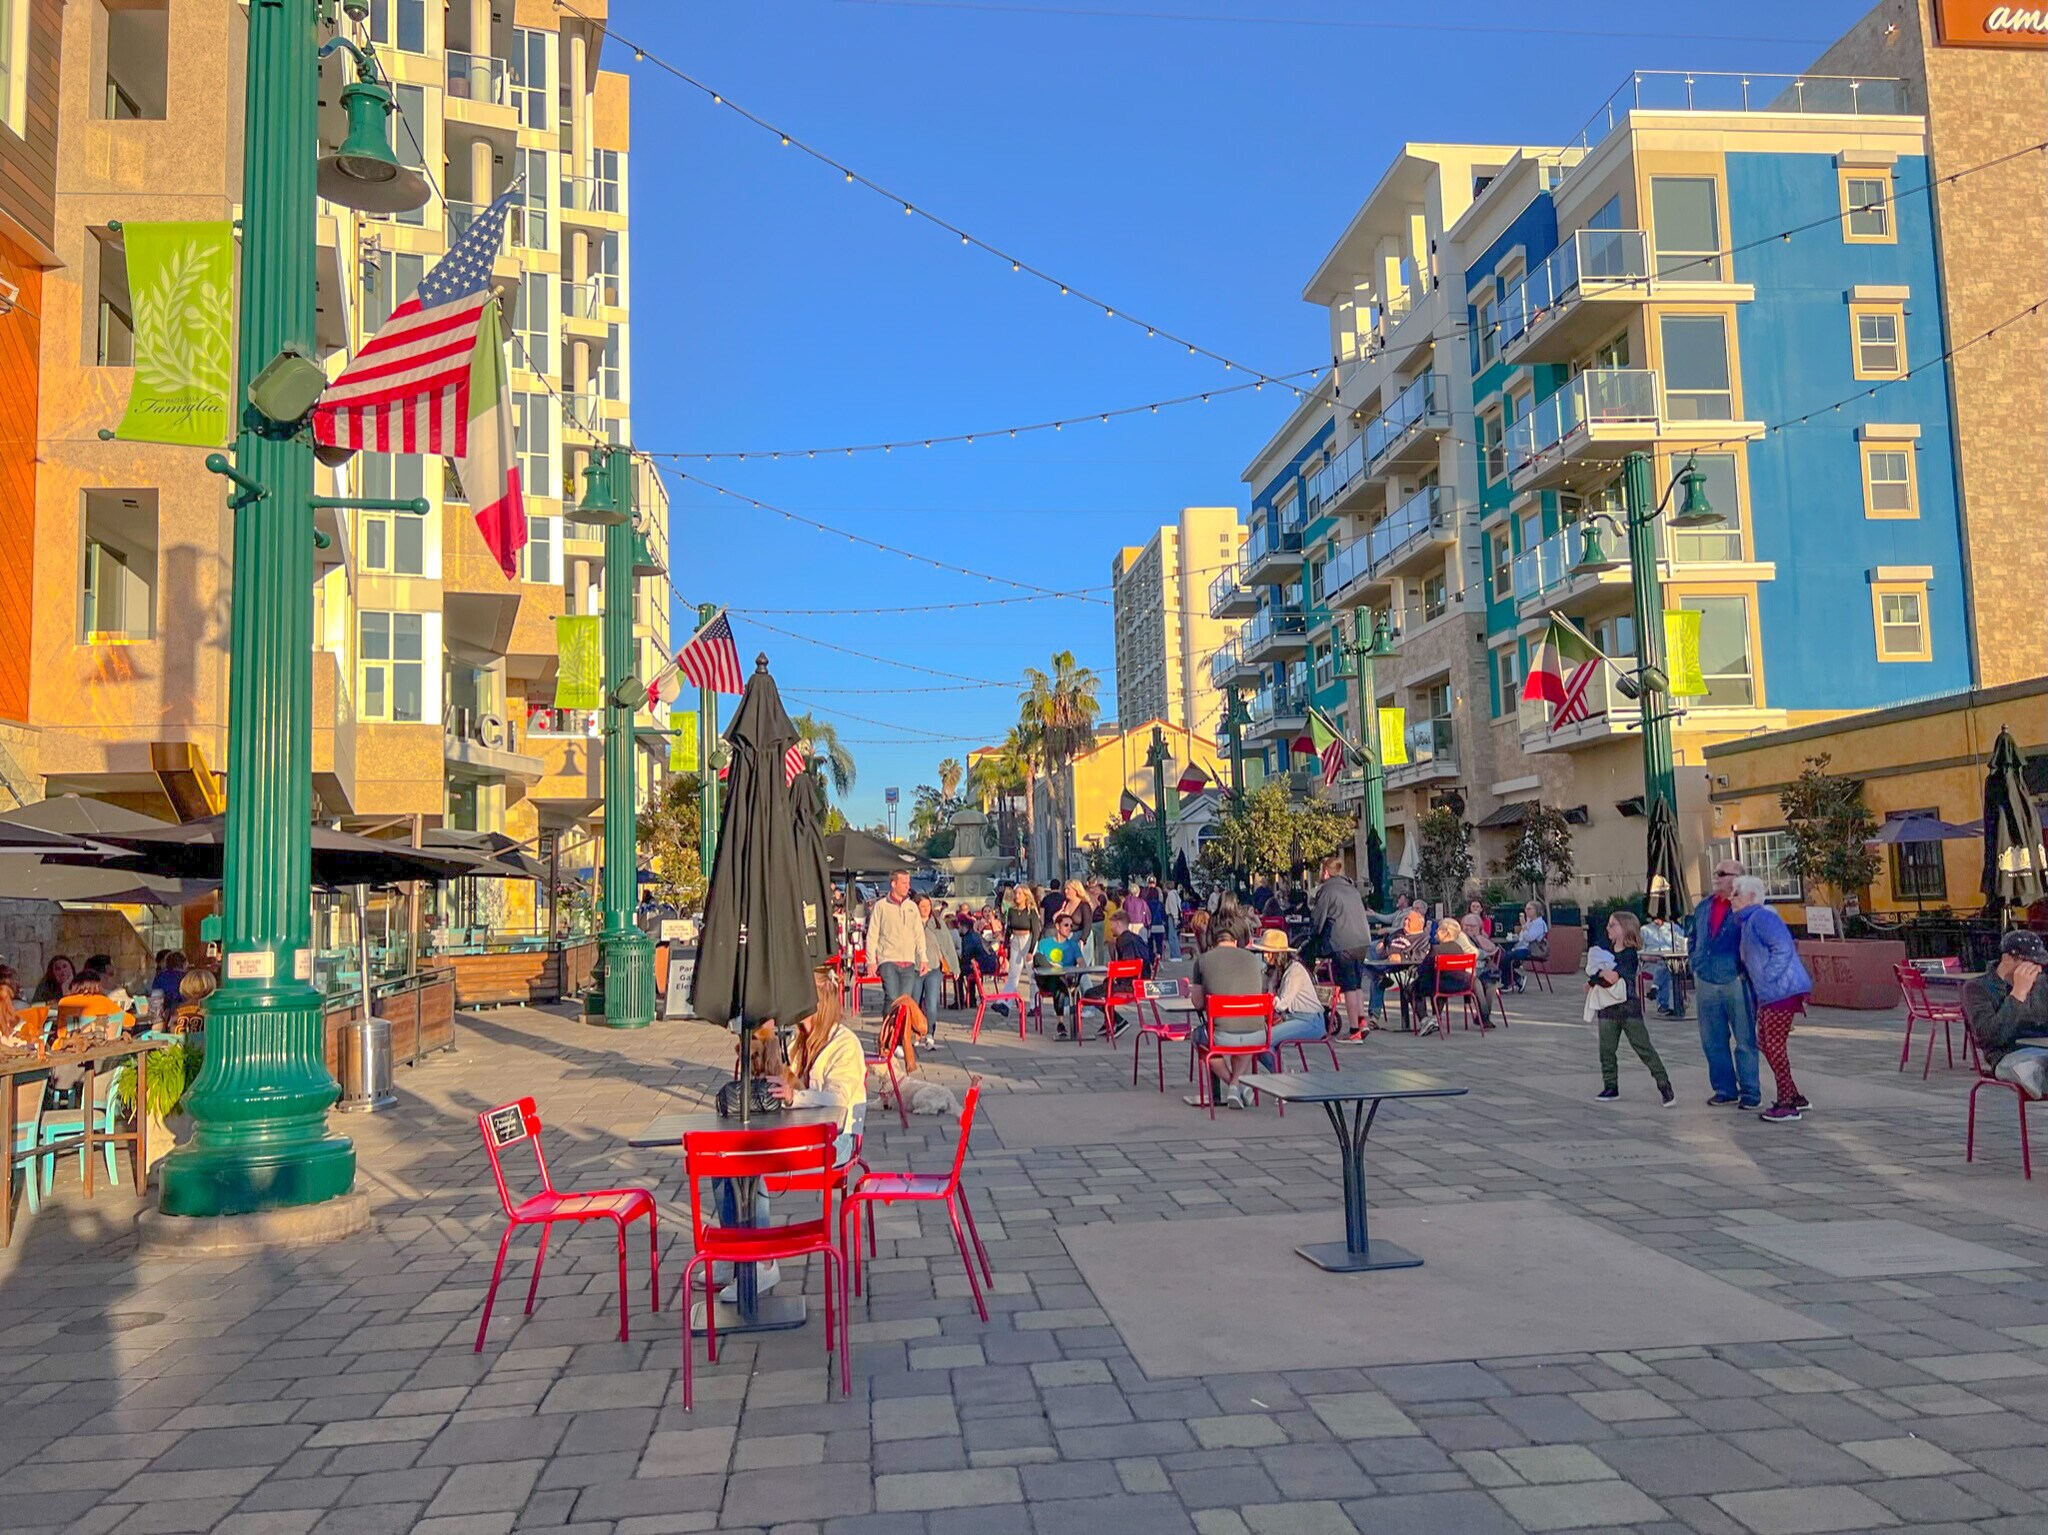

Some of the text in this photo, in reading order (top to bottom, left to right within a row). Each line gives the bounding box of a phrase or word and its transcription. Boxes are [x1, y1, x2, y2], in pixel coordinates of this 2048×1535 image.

[134, 393, 223, 426] Famiglia
[679, 965, 694, 973] Par
[679, 974, 691, 982] Ga
[675, 983, 690, 991] Ele
